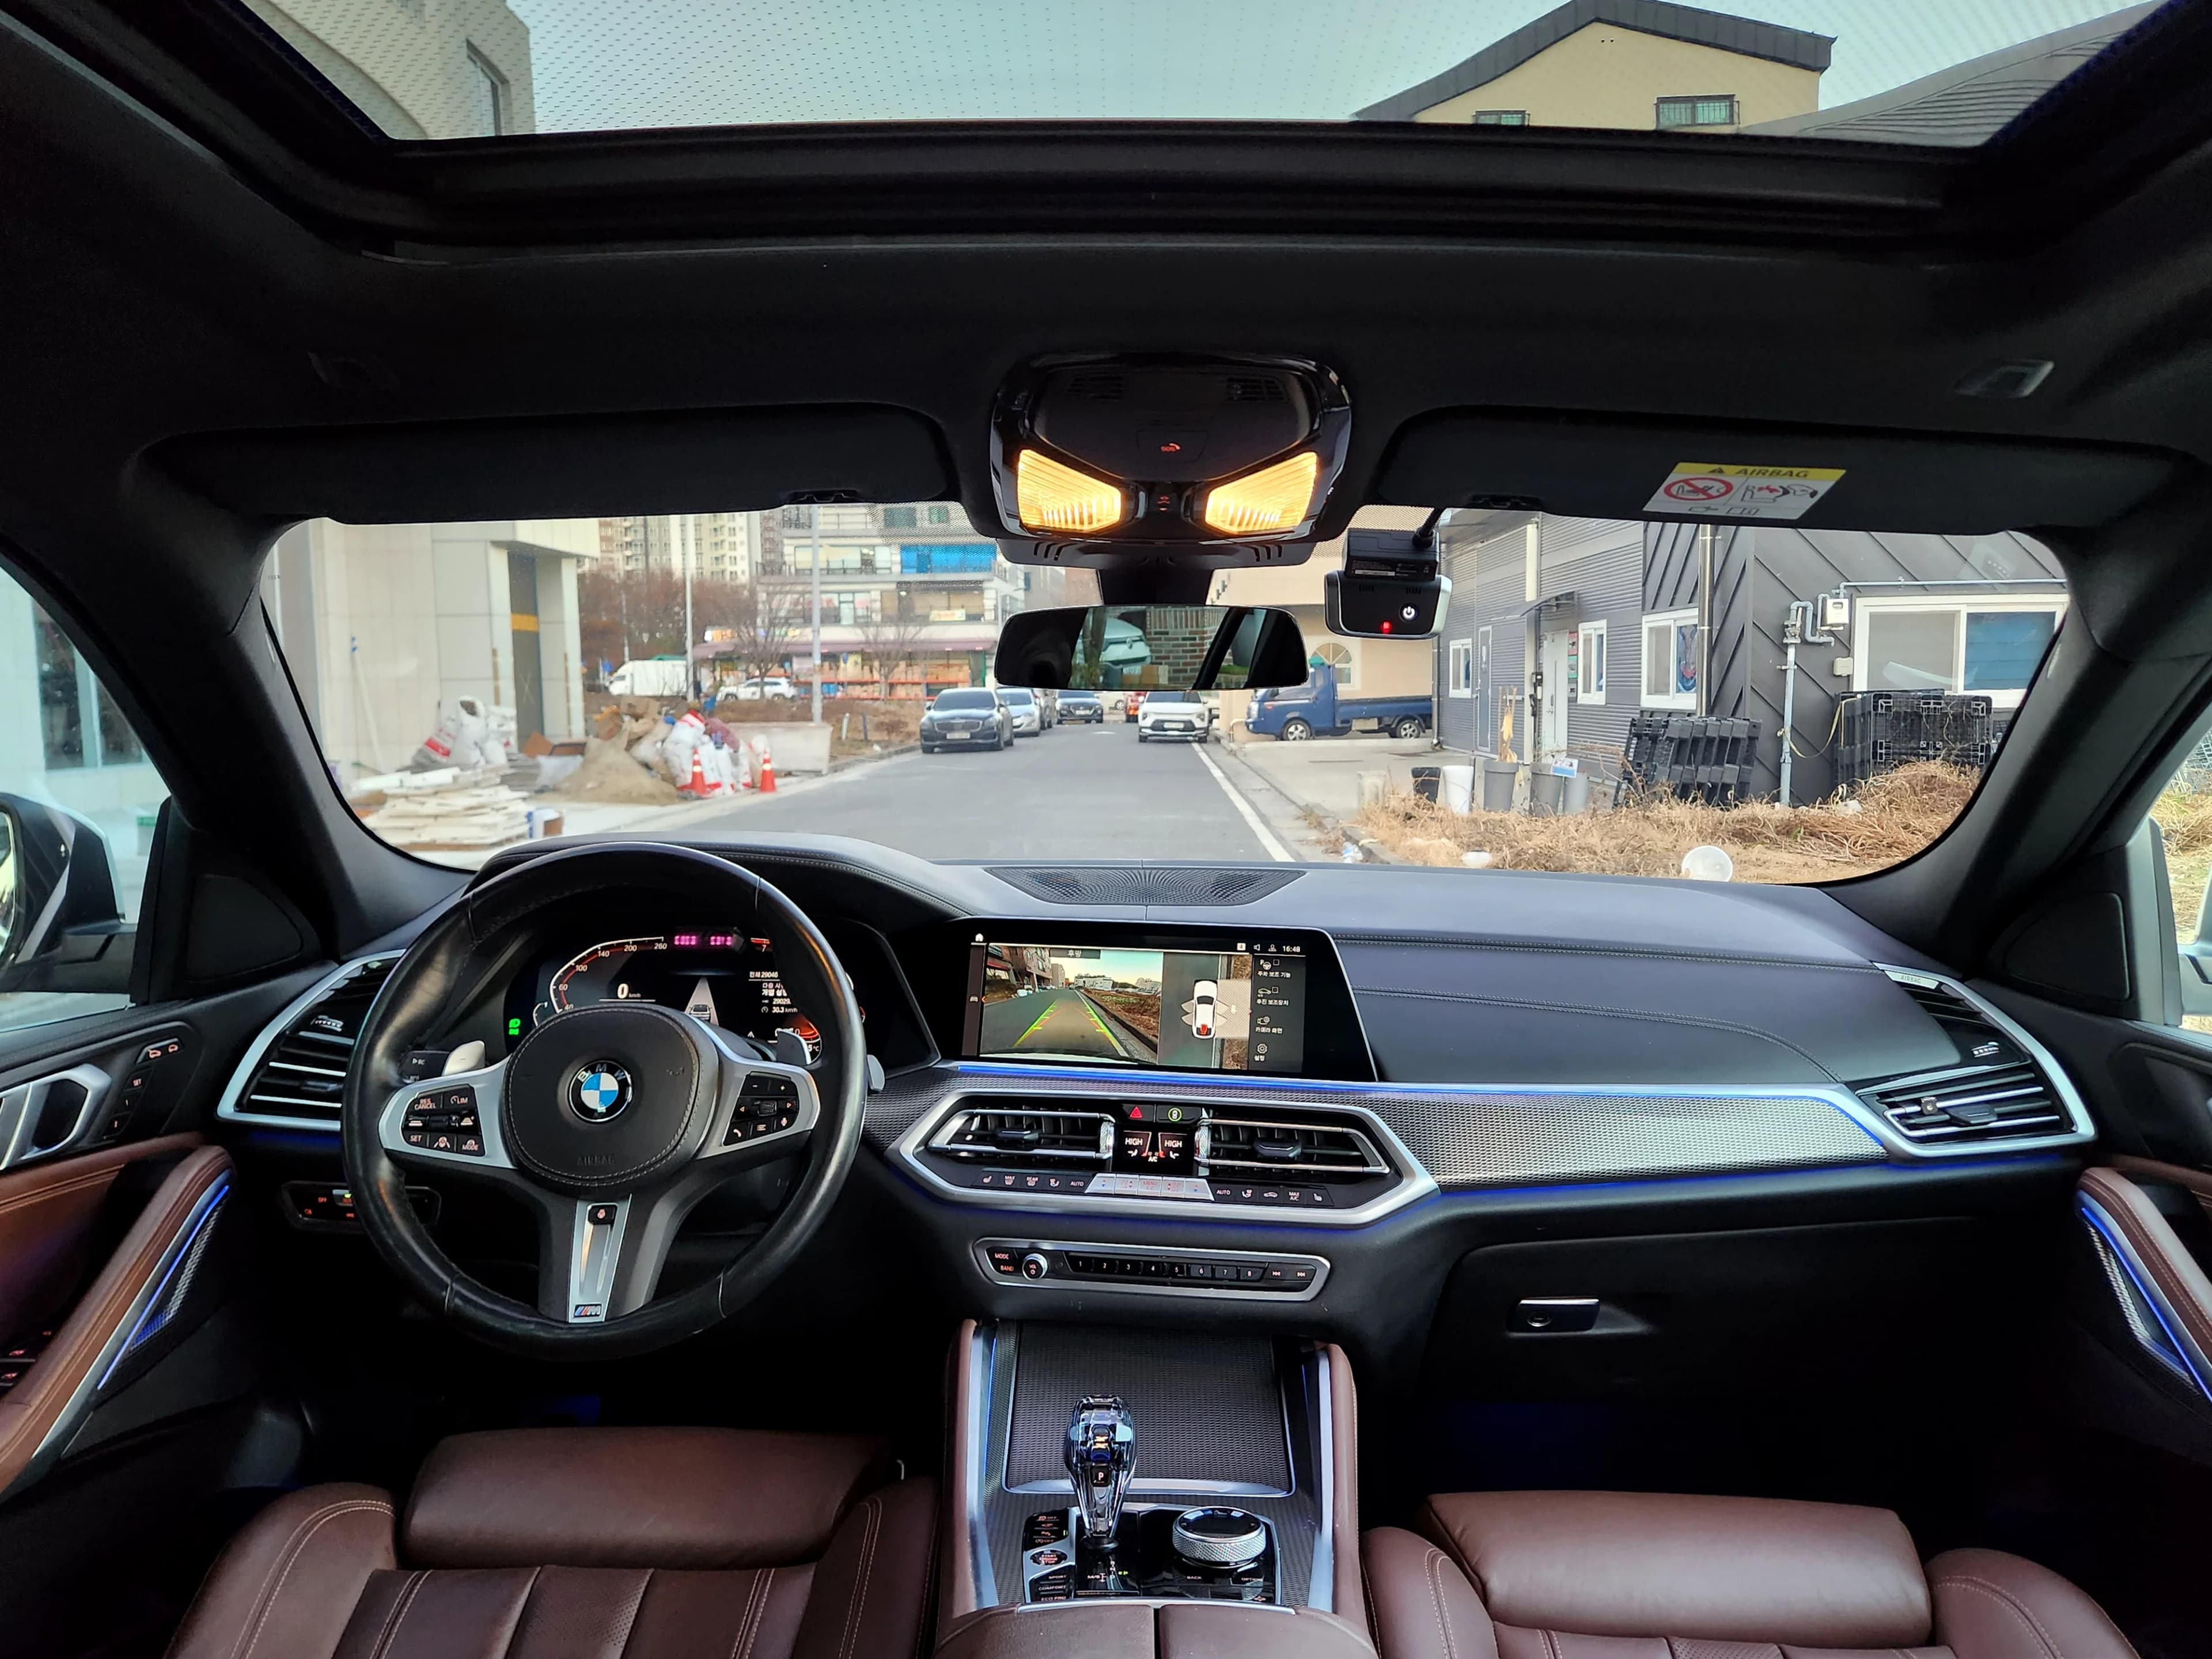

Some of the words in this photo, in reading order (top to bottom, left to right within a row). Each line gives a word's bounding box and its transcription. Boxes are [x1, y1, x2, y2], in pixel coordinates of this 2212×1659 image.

[1735, 468, 1809, 479] AIRBAG
[1067, 949, 1082, 957] 후방
[1901, 975, 1921, 984] AIRBAG
[618, 983, 628, 999] 0
[577, 1063, 626, 1082] BMW
[1125, 1138, 1143, 1146] HIGH
[1164, 1139, 1183, 1148] HIGH
[1098, 1472, 1104, 1481] P
